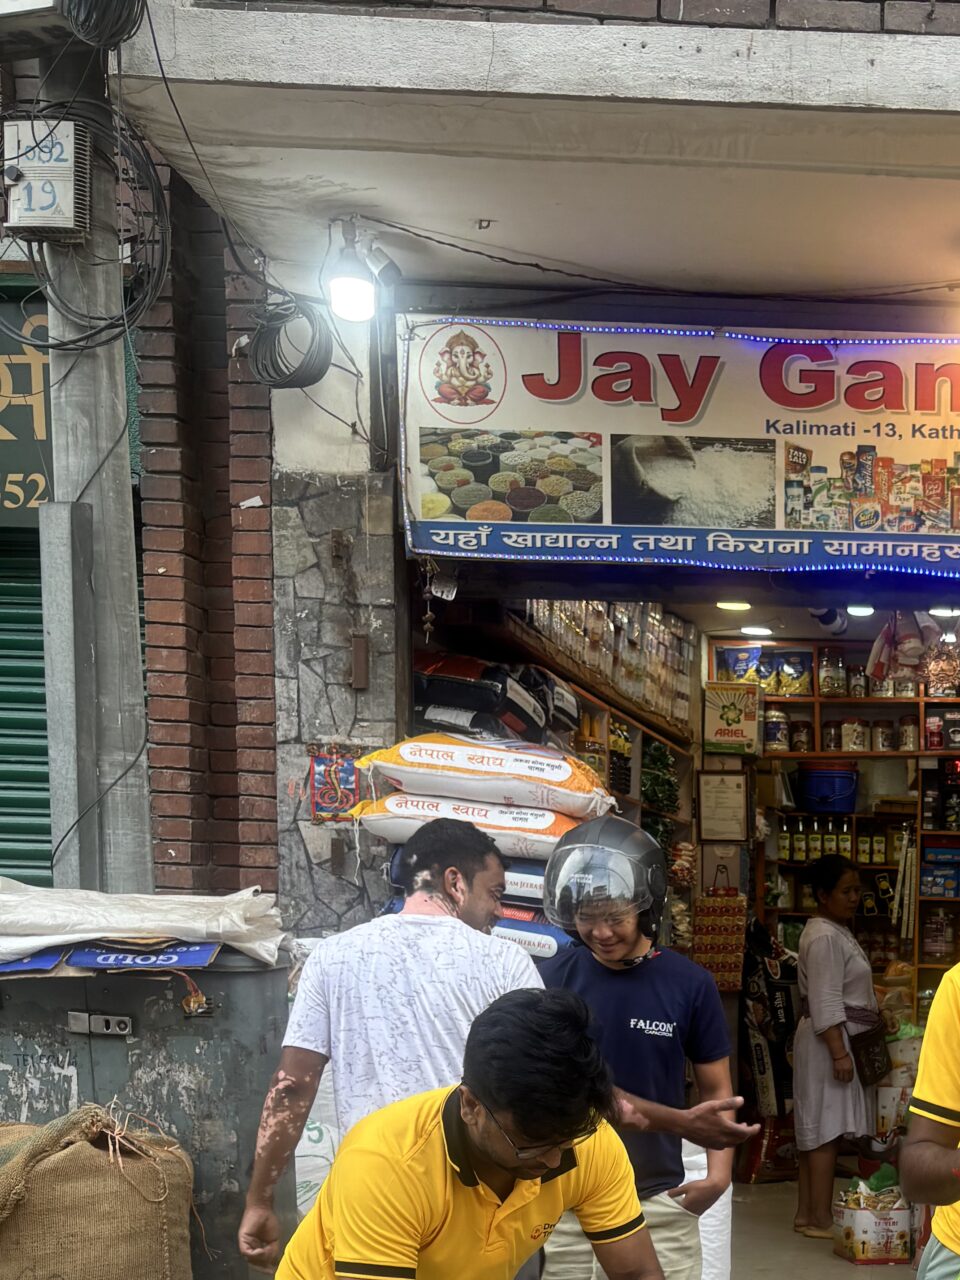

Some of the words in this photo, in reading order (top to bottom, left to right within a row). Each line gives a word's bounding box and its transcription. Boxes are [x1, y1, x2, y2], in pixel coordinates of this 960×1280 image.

[23, 180, 57, 212] 19
[522, 332, 720, 423] Jay
[765, 419, 856, 438] Kalimati
[863, 423, 903, 441] -13,
[430, 526, 493, 549] यहाँ
[502, 531, 620, 551] खाद्यान्न
[633, 535, 693, 553] तथा
[707, 532, 811, 555] किराना
[714, 727, 747, 738] ARIEL
[409, 745, 455, 761] नेपाल
[396, 797, 441, 812] नेपाल
[630, 1018, 674, 1032] FALCON
